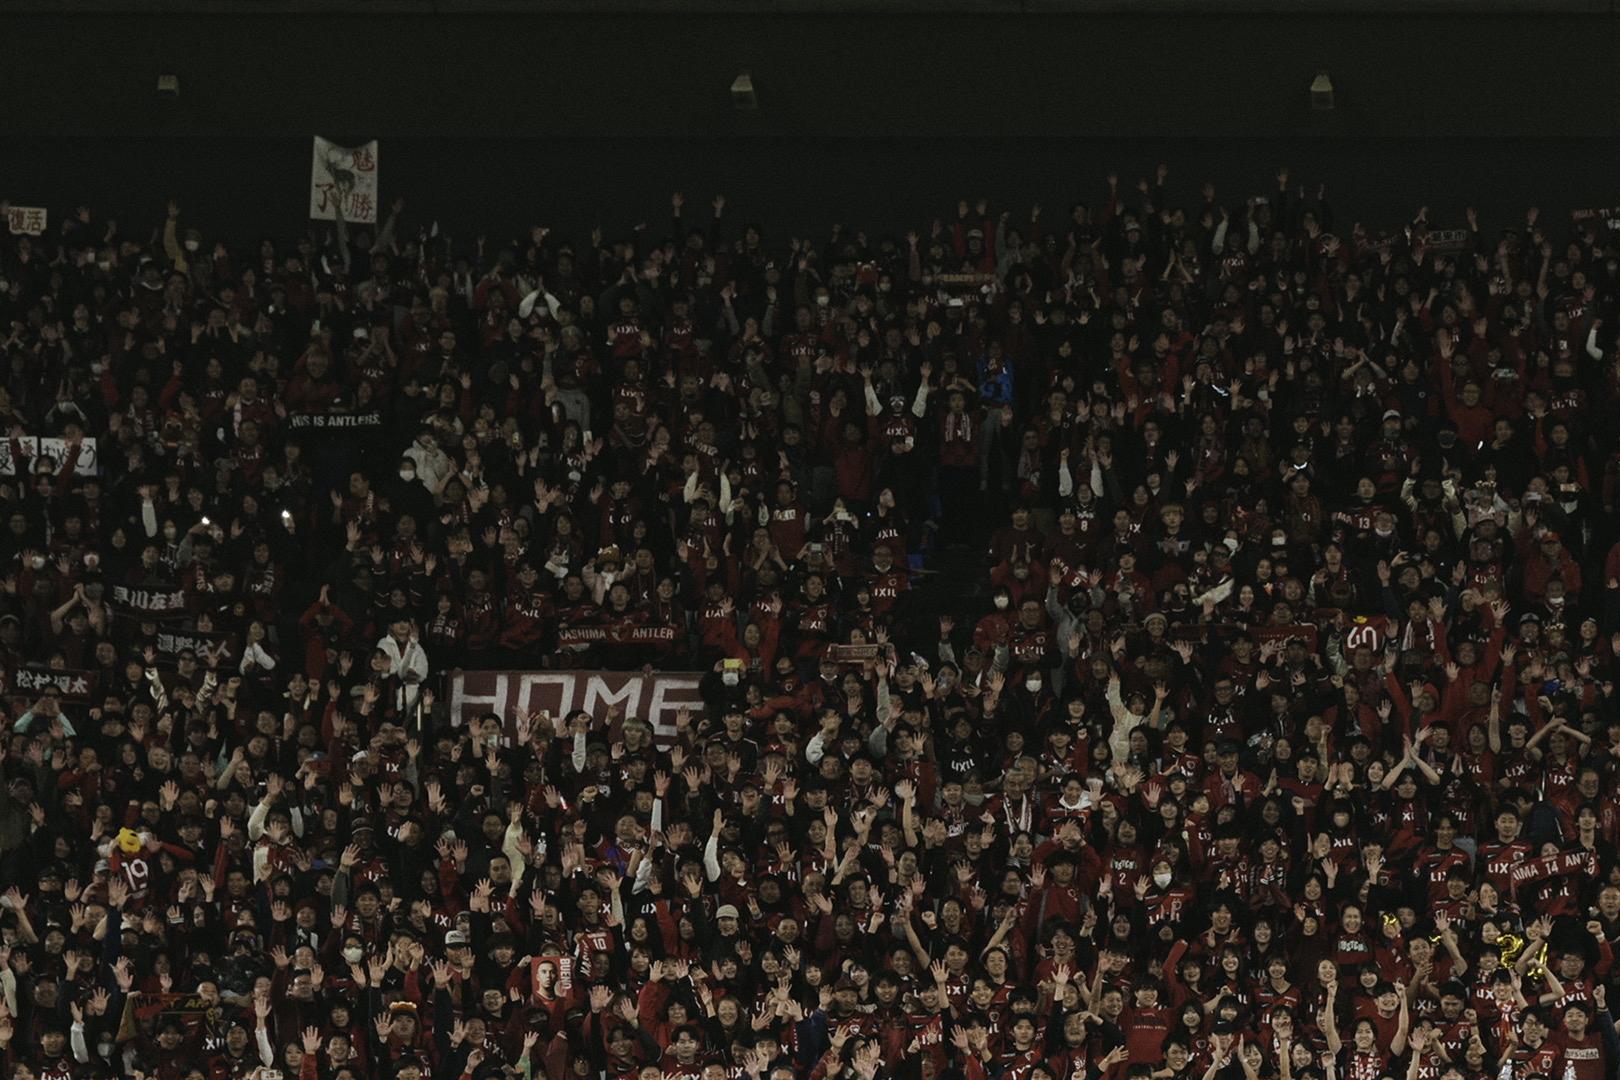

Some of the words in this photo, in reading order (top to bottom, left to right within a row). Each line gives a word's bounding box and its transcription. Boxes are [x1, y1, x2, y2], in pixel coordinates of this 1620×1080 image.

[9, 209, 43, 231] 復活
[451, 674, 705, 737] HOME
[950, 759, 975, 772] LIXIL
[1332, 836, 1353, 848] XIL
[120, 858, 149, 891] 19
[1545, 861, 1560, 875] 14
[557, 958, 573, 991] BUENO
[1554, 989, 1592, 1010] LIXIL
